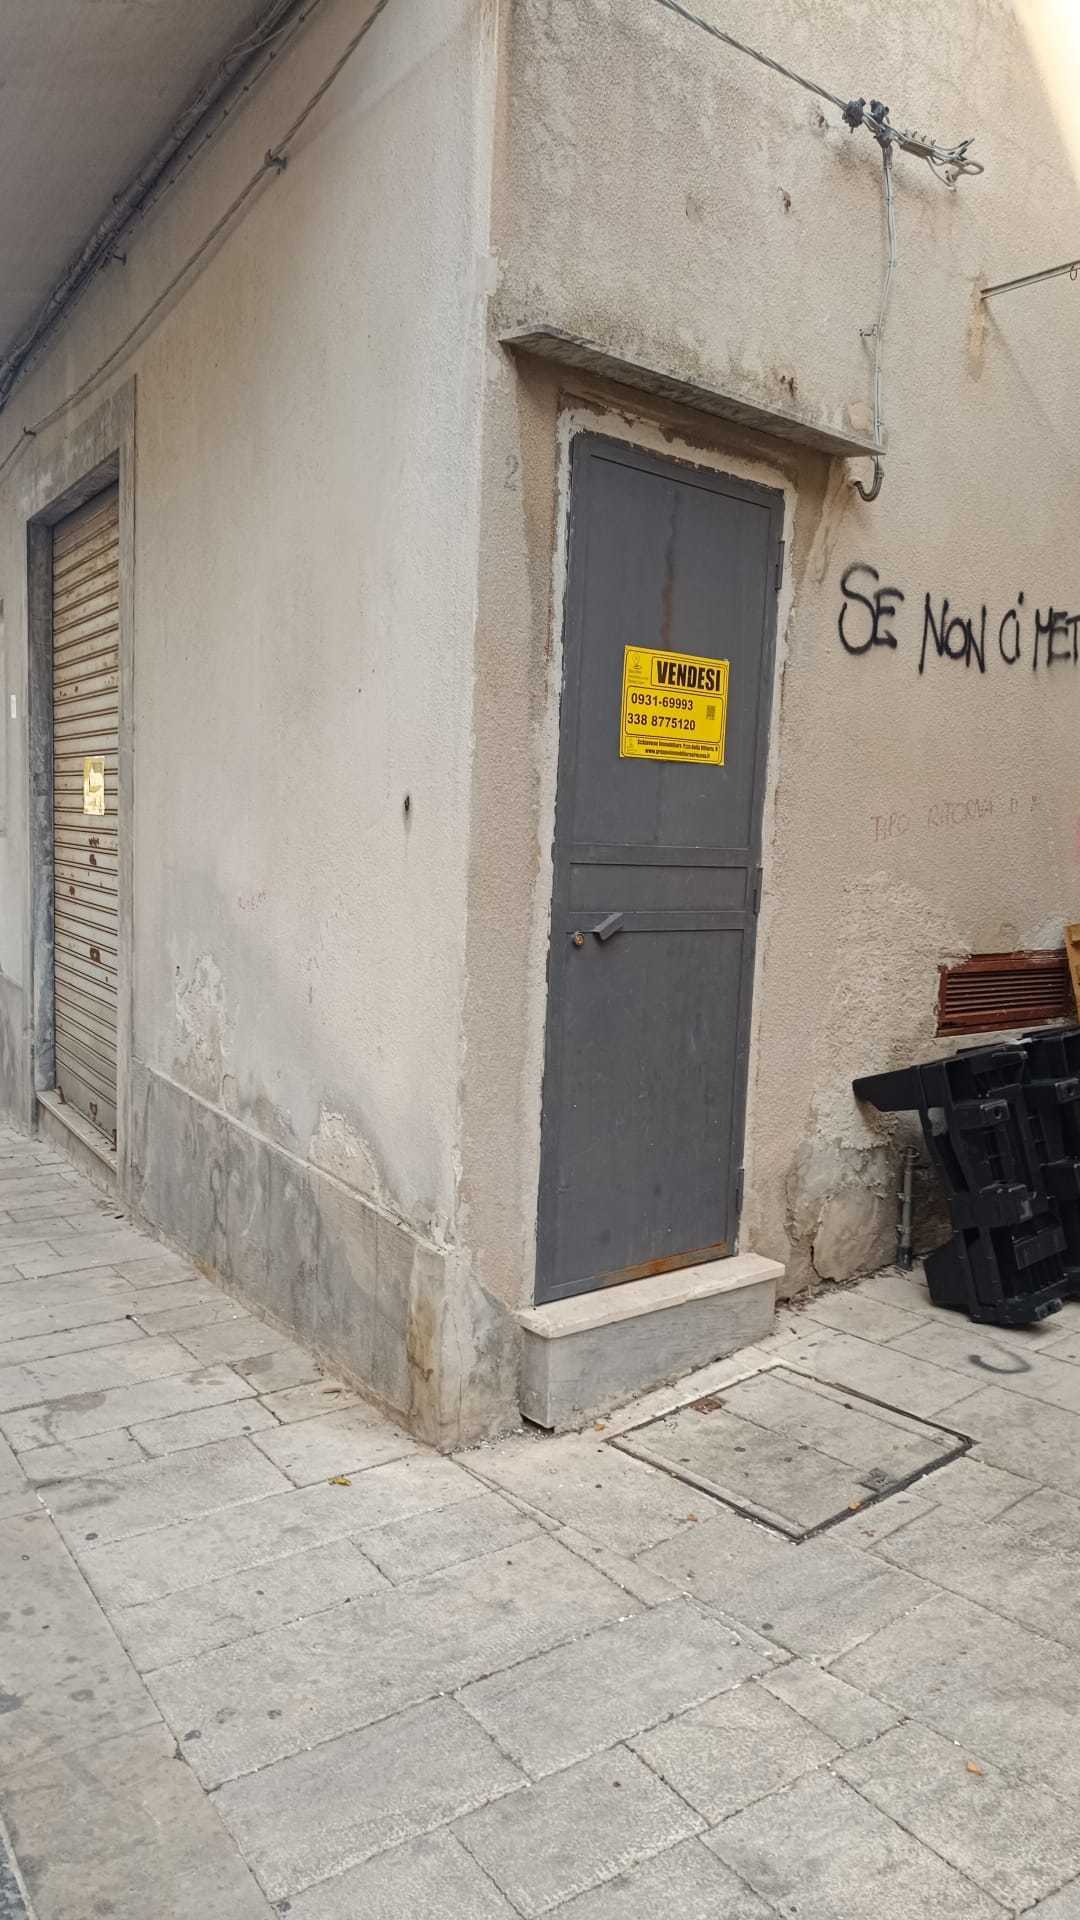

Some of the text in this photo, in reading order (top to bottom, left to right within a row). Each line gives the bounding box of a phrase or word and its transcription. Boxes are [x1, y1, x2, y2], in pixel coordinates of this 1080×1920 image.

[503, 454, 520, 490] 2
[838, 562, 905, 656] SE
[656, 660, 720, 692] VENDESI
[631, 692, 694, 711] 0931-69993
[627, 712, 696, 731] 338 8775120
